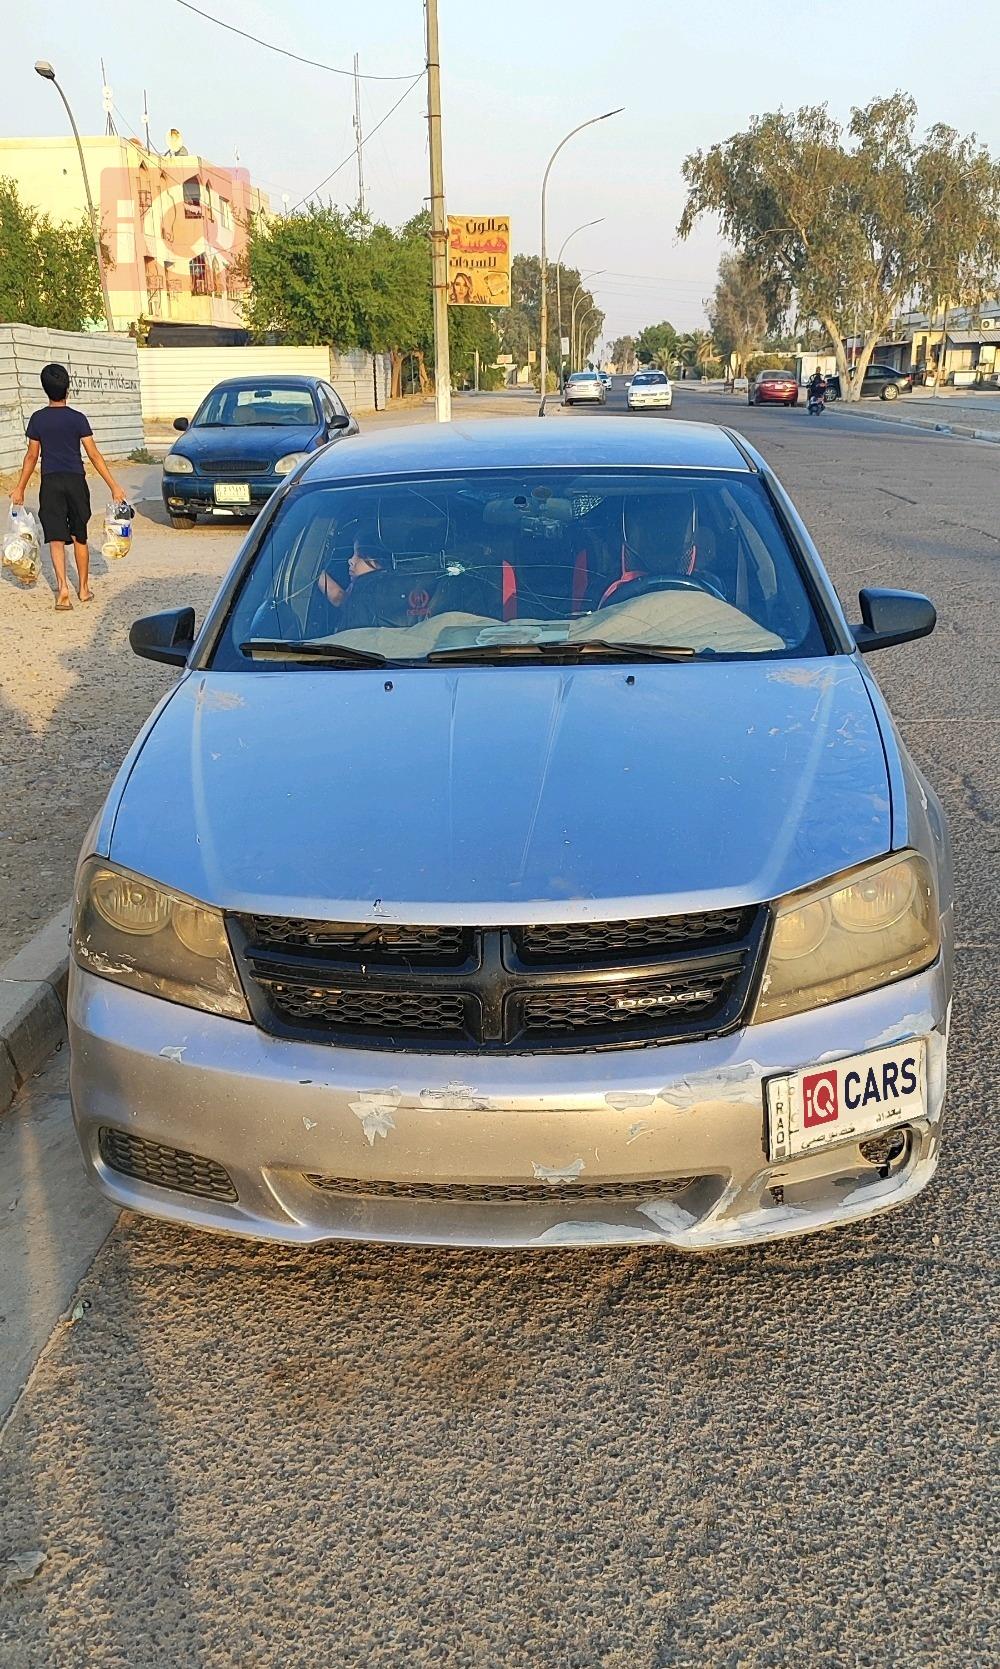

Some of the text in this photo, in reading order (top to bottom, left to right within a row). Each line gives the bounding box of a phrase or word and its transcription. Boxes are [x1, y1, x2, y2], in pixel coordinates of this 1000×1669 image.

[466, 219, 508, 235] صالون
[449, 256, 497, 270] للسيدات
[616, 990, 713, 1008] DODGE
